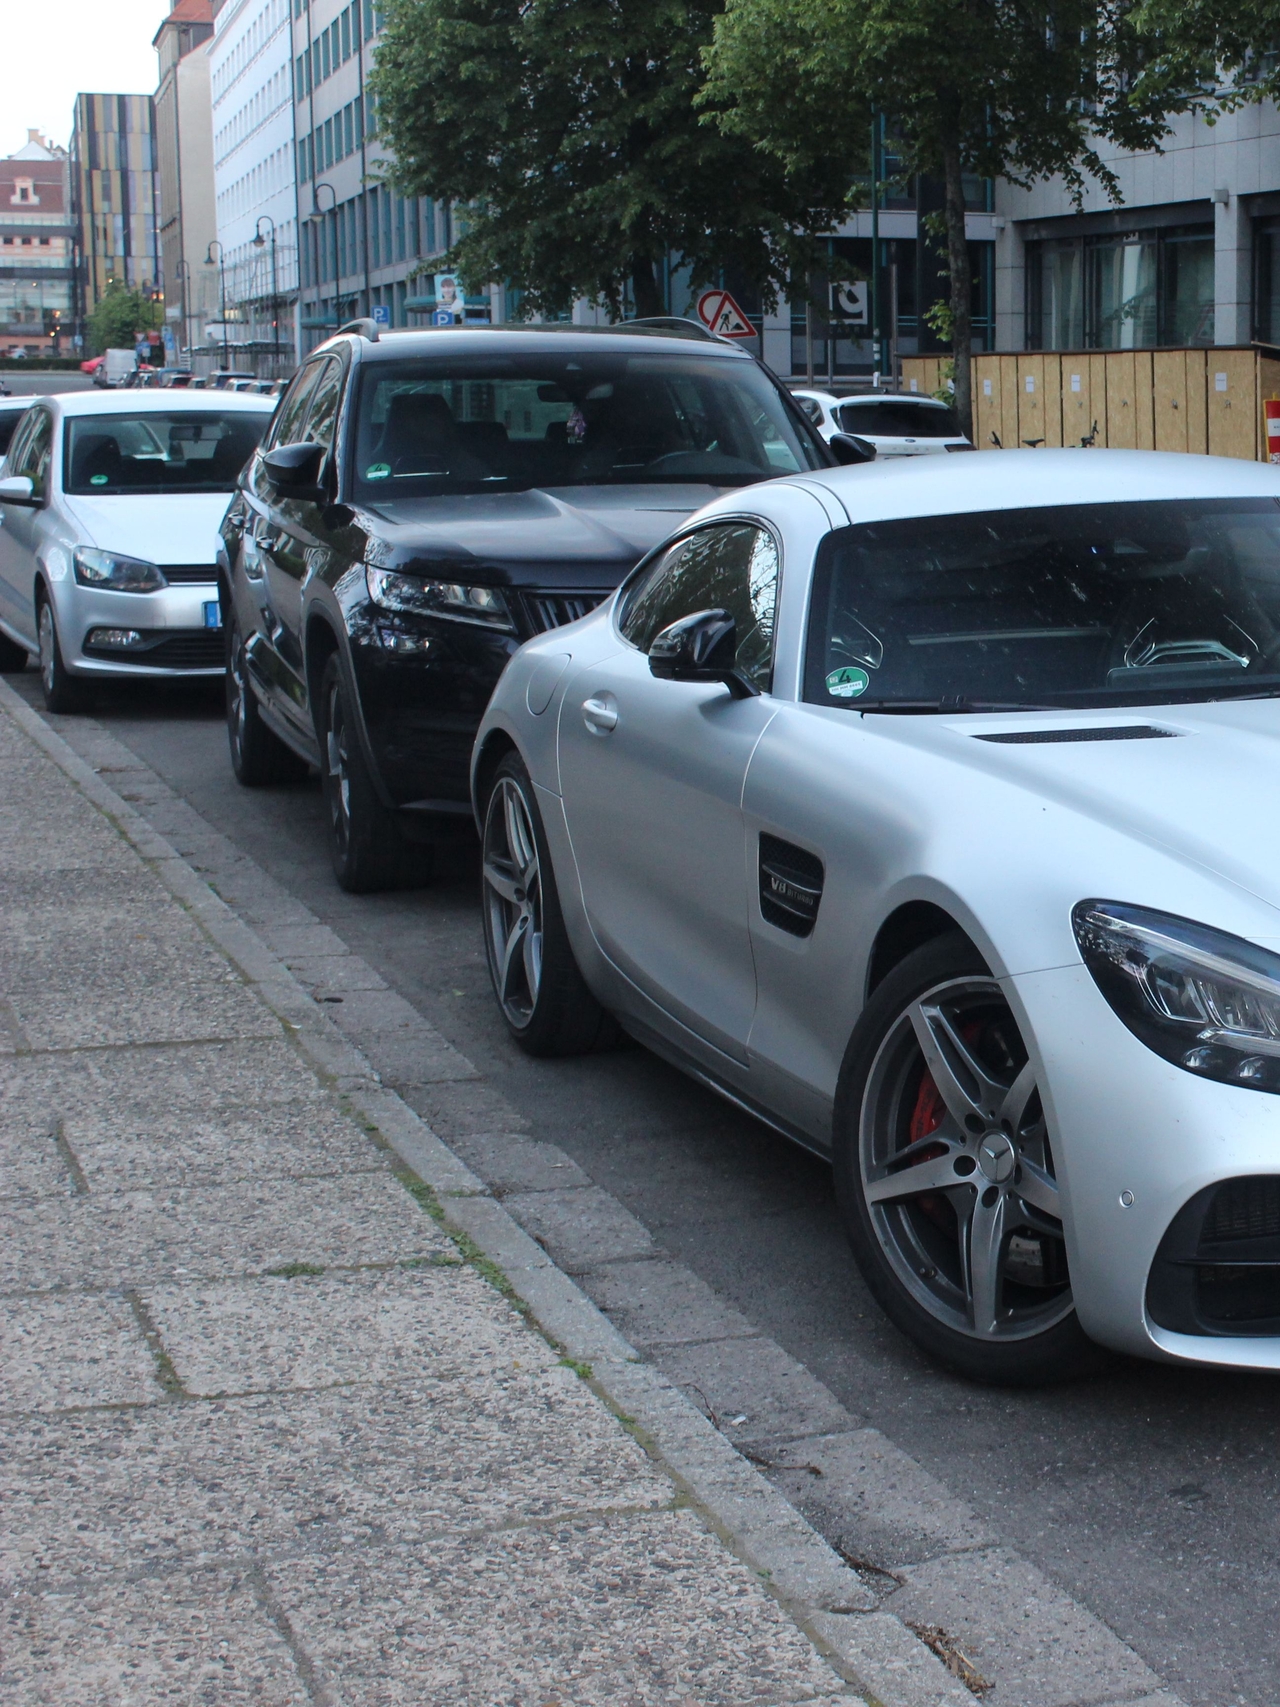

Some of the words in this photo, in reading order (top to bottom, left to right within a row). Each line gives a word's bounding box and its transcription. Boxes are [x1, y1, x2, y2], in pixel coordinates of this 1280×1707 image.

[374, 308, 384, 320] P
[437, 314, 449, 326] P
[839, 669, 852, 683] 4
[771, 877, 786, 893] V8
